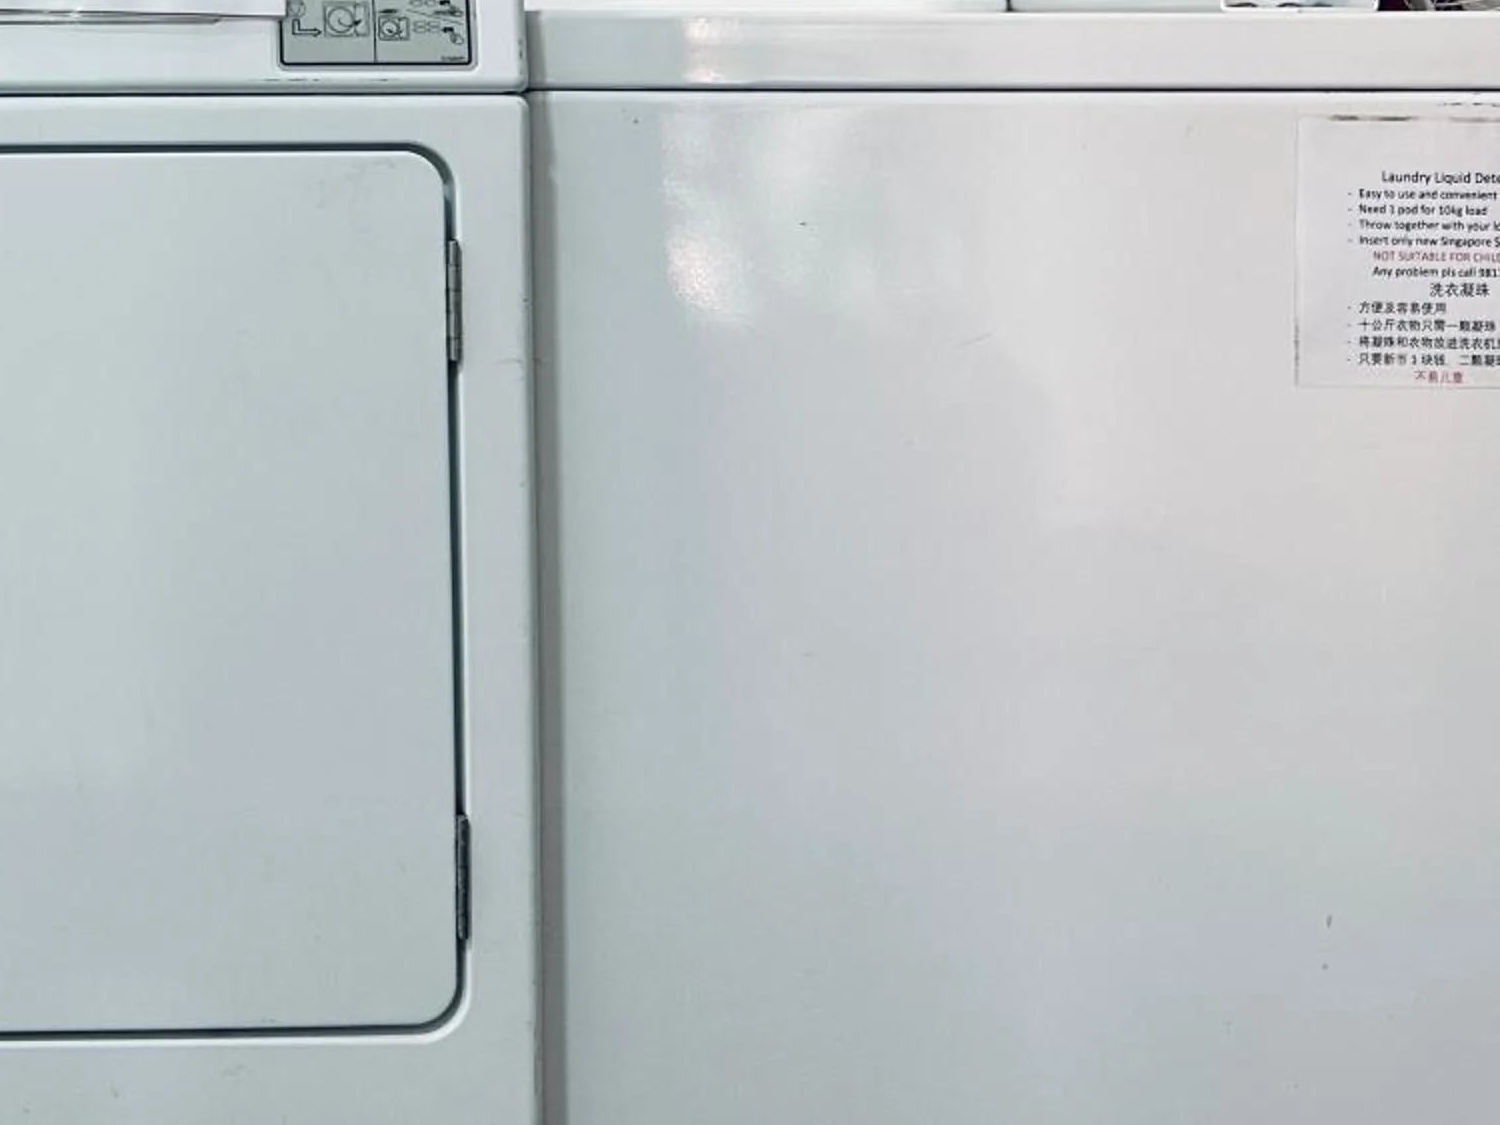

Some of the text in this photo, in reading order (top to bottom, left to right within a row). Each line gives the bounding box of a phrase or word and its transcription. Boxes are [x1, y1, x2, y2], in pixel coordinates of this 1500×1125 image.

[1381, 171, 1431, 185] Laundry
[1435, 171, 1471, 185] Liquid
[1358, 188, 1497, 200] Easy to use and convenient
[1358, 204, 1386, 215] Need
[1397, 204, 1418, 216] pod
[1420, 204, 1436, 215] for
[1439, 205, 1463, 217] 10kg
[1465, 205, 1488, 216] load
[1359, 218, 1391, 229] Throw
[1395, 220, 1439, 231] together
[1441, 220, 1464, 230] with
[1467, 222, 1491, 232] your
[1359, 235, 1389, 246] Insert
[1391, 236, 1412, 247] only
[1416, 236, 1437, 246] new
[1440, 236, 1492, 248] Singapore
[1373, 250, 1395, 261] NOT
[1398, 251, 1447, 262] SUITABLE
[1449, 251, 1471, 262] FOR
[1372, 267, 1500, 278] Any problem pls call 981
[1429, 282, 1490, 298] 洗衣凝珠
